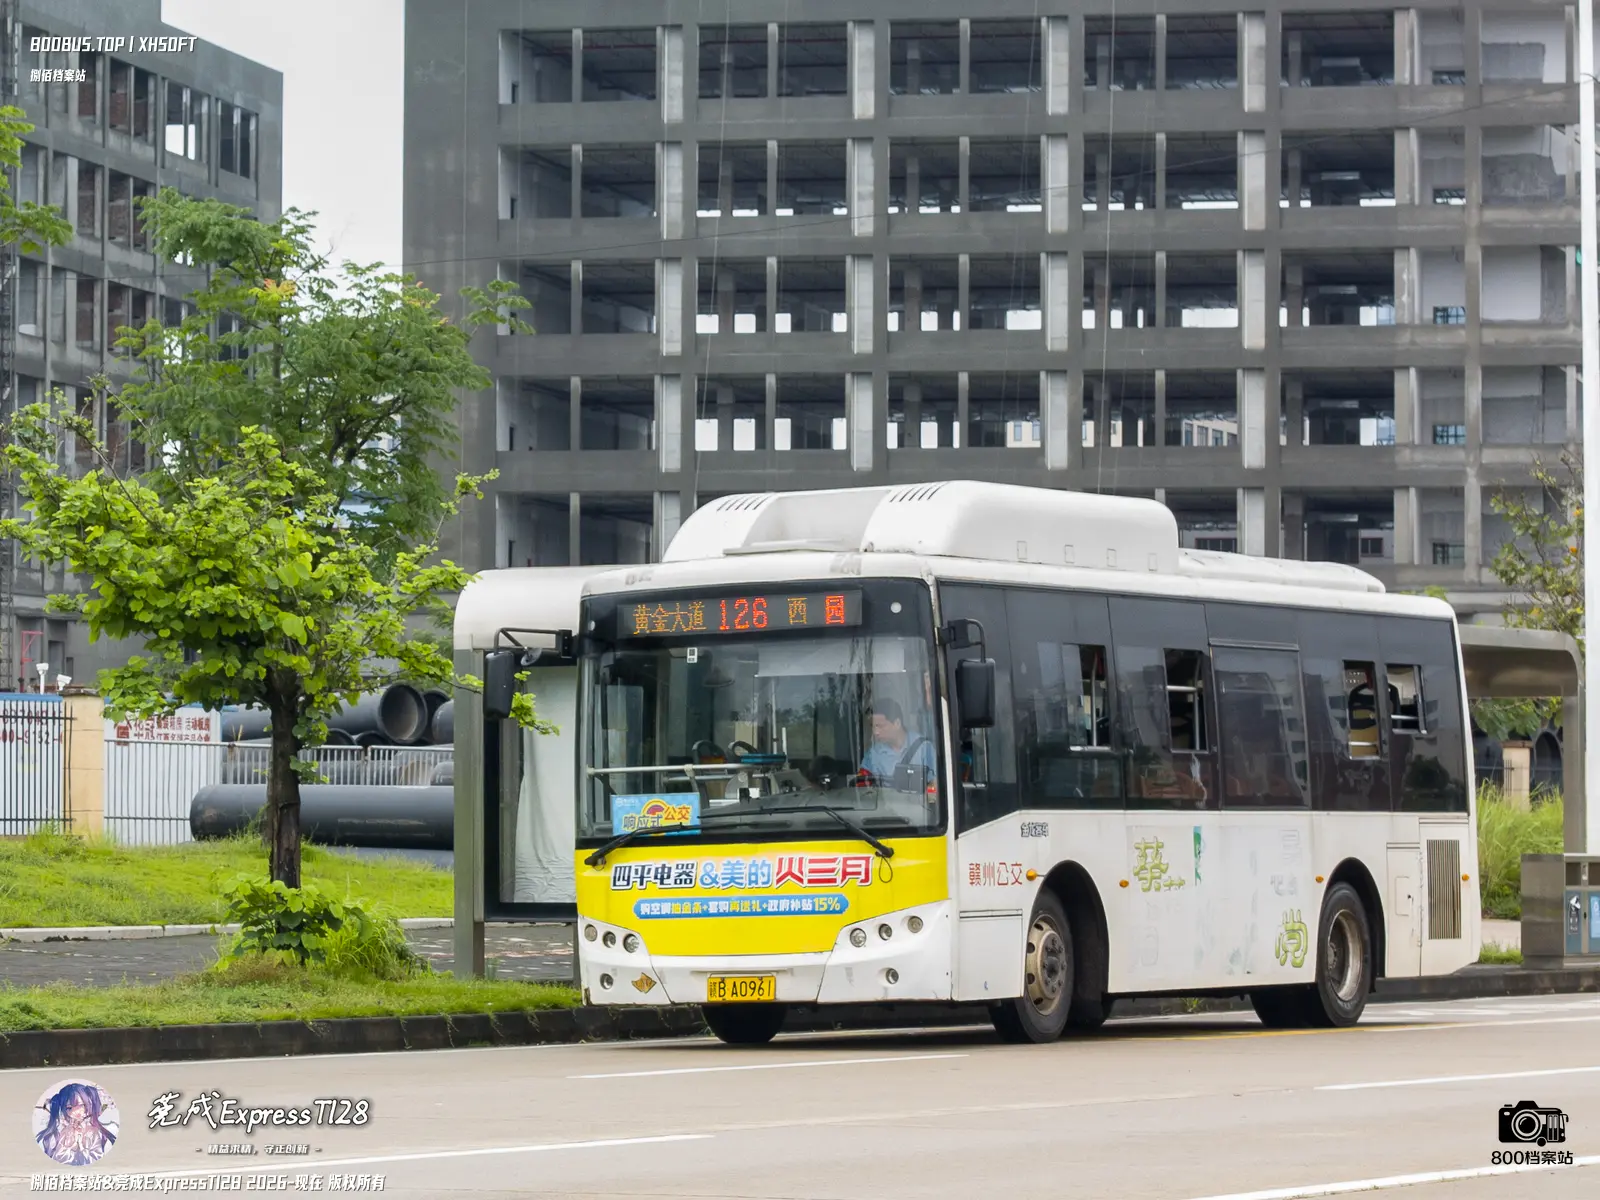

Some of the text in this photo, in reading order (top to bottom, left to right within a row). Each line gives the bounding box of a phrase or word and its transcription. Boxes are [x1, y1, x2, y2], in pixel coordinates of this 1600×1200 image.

[632, 601, 707, 635] 黄金大道
[719, 597, 768, 631] 126
[968, 861, 1023, 887] 赣州公交
